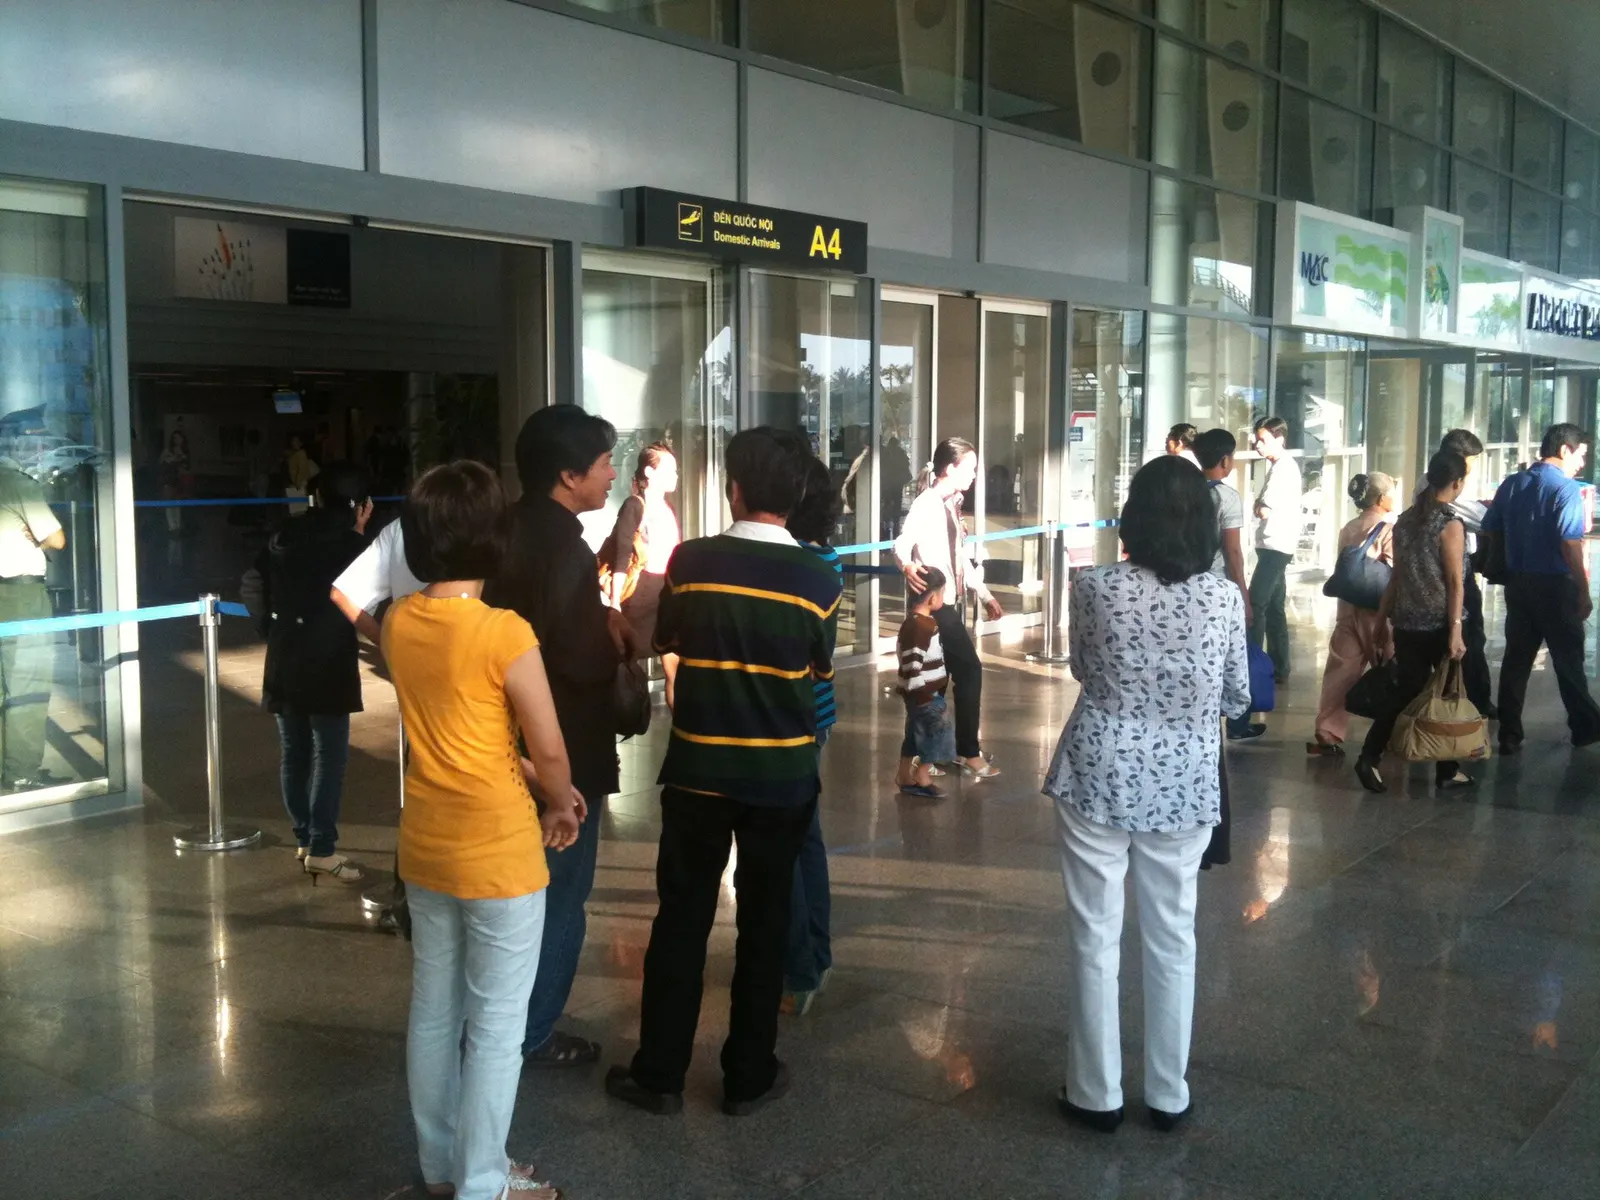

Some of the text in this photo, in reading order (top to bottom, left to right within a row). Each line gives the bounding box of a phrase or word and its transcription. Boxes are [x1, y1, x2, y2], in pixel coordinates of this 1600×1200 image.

[713, 230, 781, 250] Domestic Arrivals
[809, 225, 842, 260] A4
